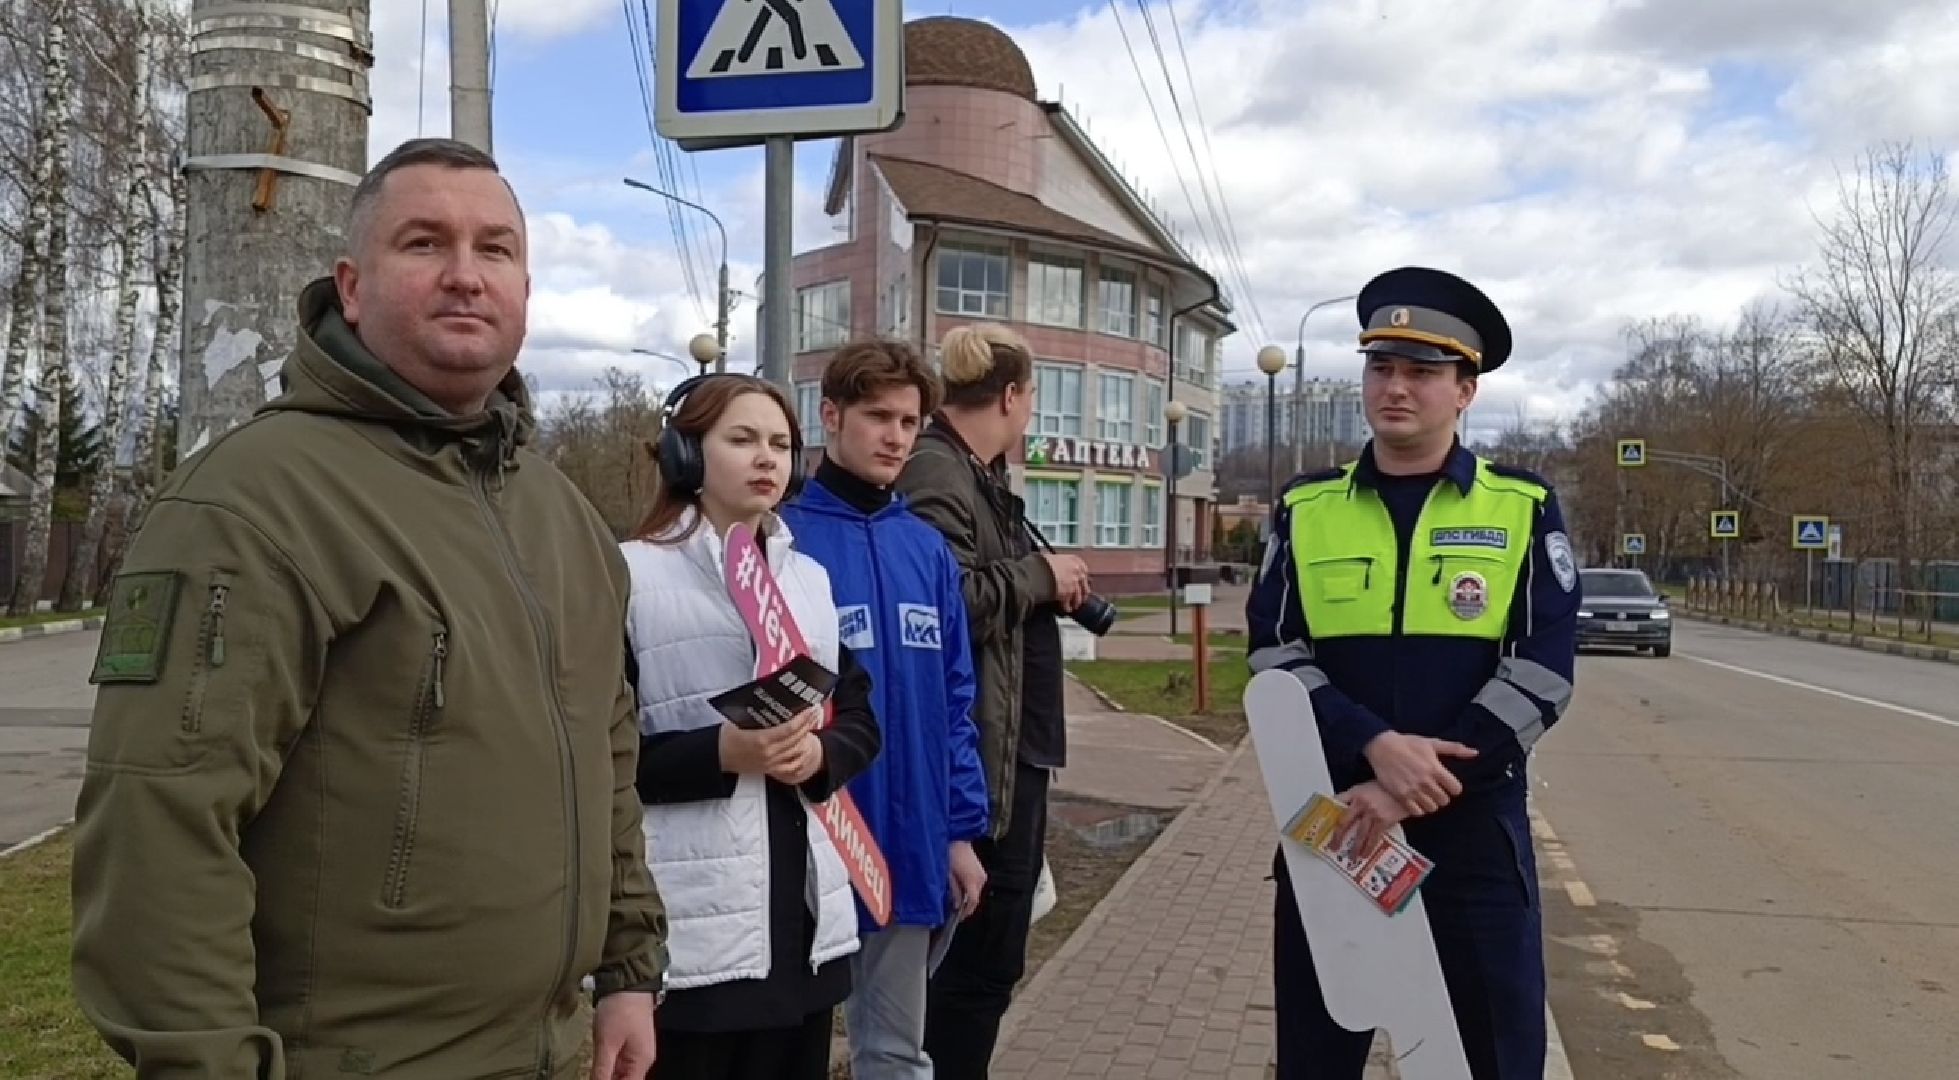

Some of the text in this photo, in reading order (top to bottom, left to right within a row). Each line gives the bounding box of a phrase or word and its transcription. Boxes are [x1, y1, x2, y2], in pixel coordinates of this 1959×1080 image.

[1052, 438, 1150, 468] АПТЕКА
[1434, 530, 1504, 543] ДПС ГИБДД
[822, 792, 885, 916] димец
